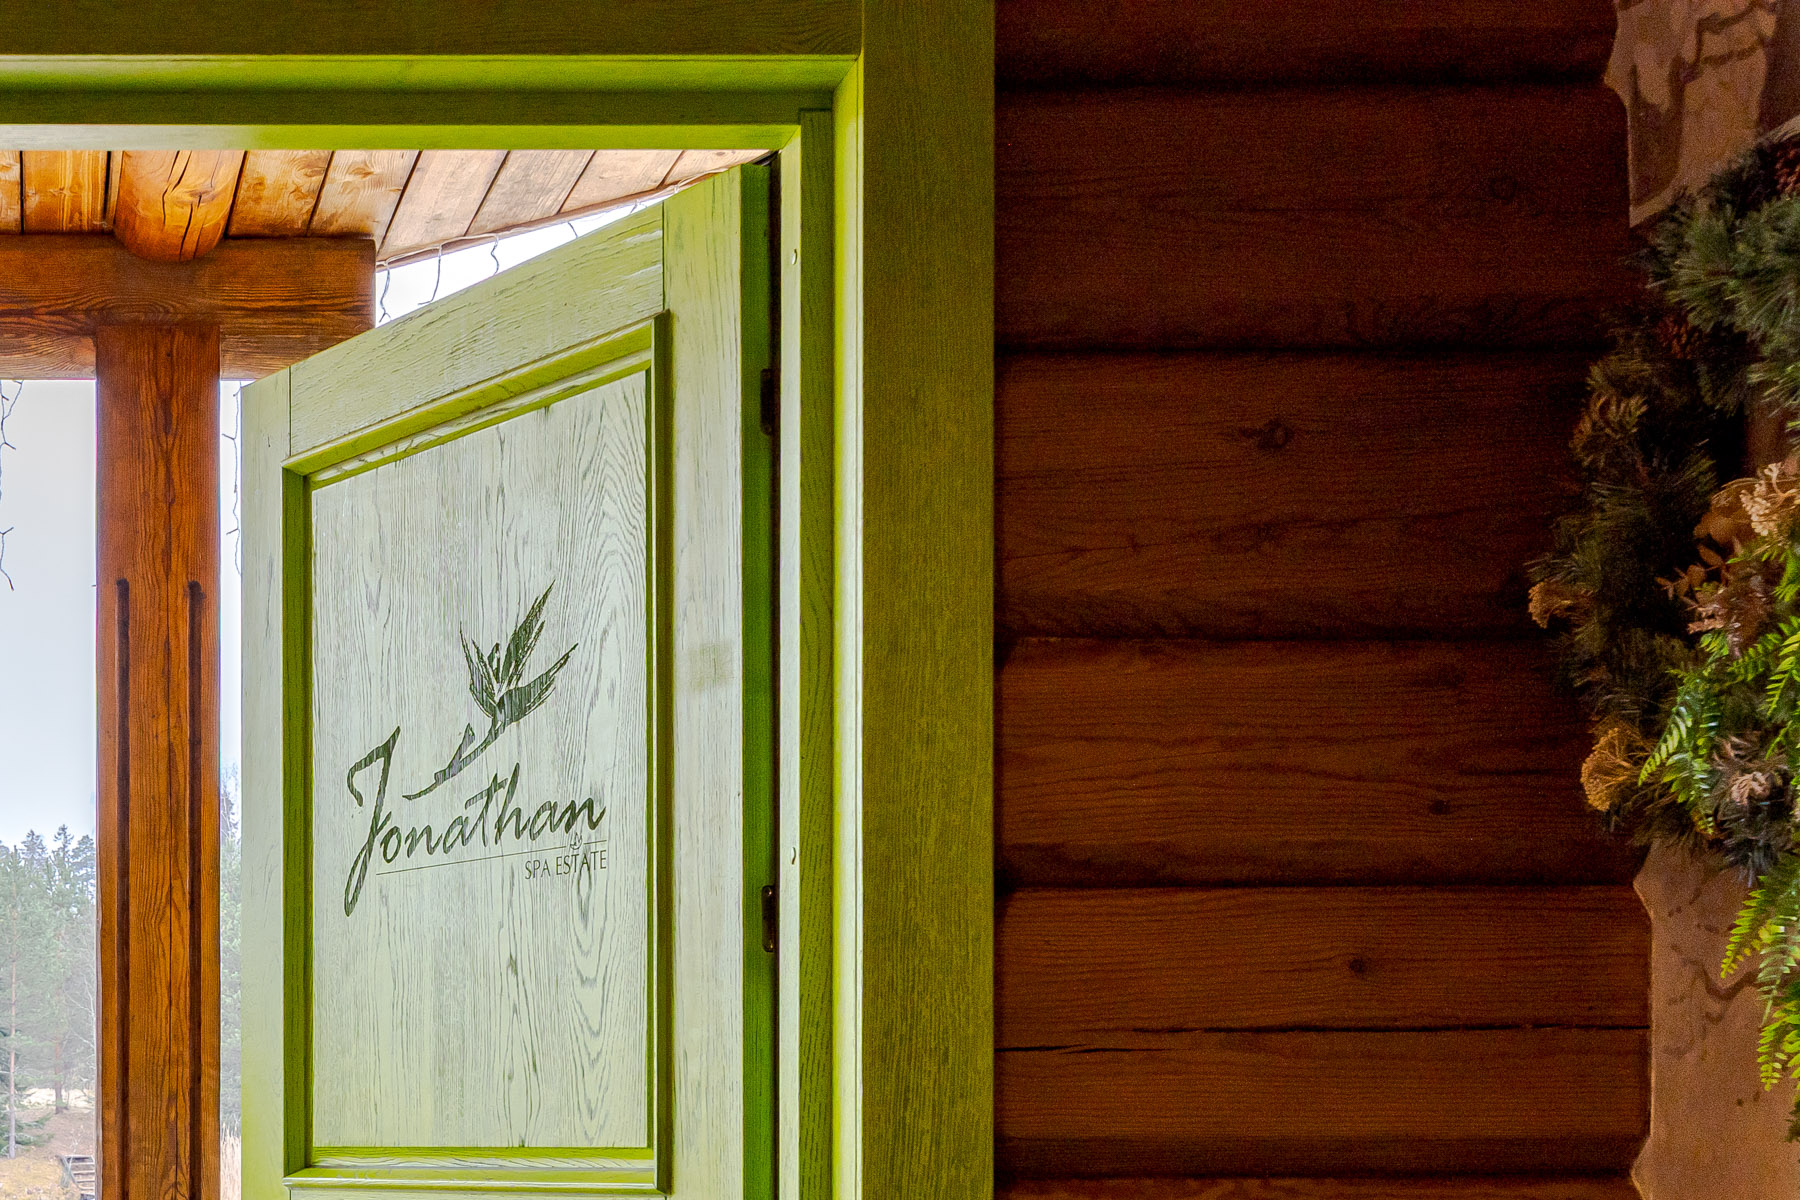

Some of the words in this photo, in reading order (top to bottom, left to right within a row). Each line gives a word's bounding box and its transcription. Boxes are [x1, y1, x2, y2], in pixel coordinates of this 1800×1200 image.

[343, 725, 607, 917] Jonathan
[524, 857, 552, 880] SPA
[555, 849, 608, 876] ESTATE
